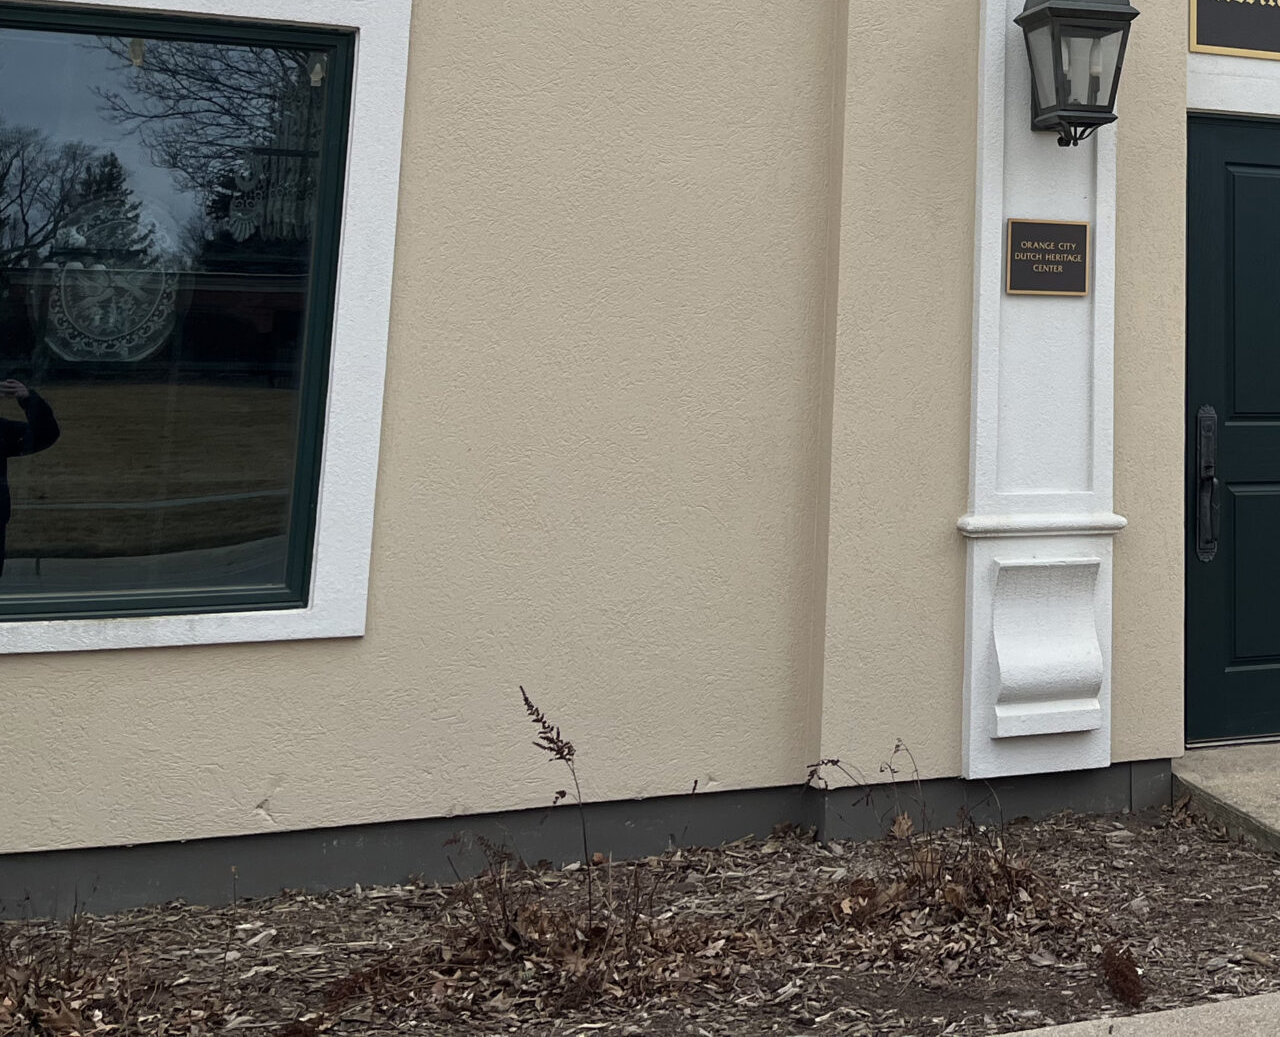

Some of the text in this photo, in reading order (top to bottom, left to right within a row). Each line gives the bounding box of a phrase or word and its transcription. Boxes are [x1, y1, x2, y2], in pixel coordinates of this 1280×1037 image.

[1020, 241, 1077, 251] ORANGE CITY
[1014, 252, 1082, 262] DUTCH HERITAGE
[1032, 264, 1063, 273] CENTER
